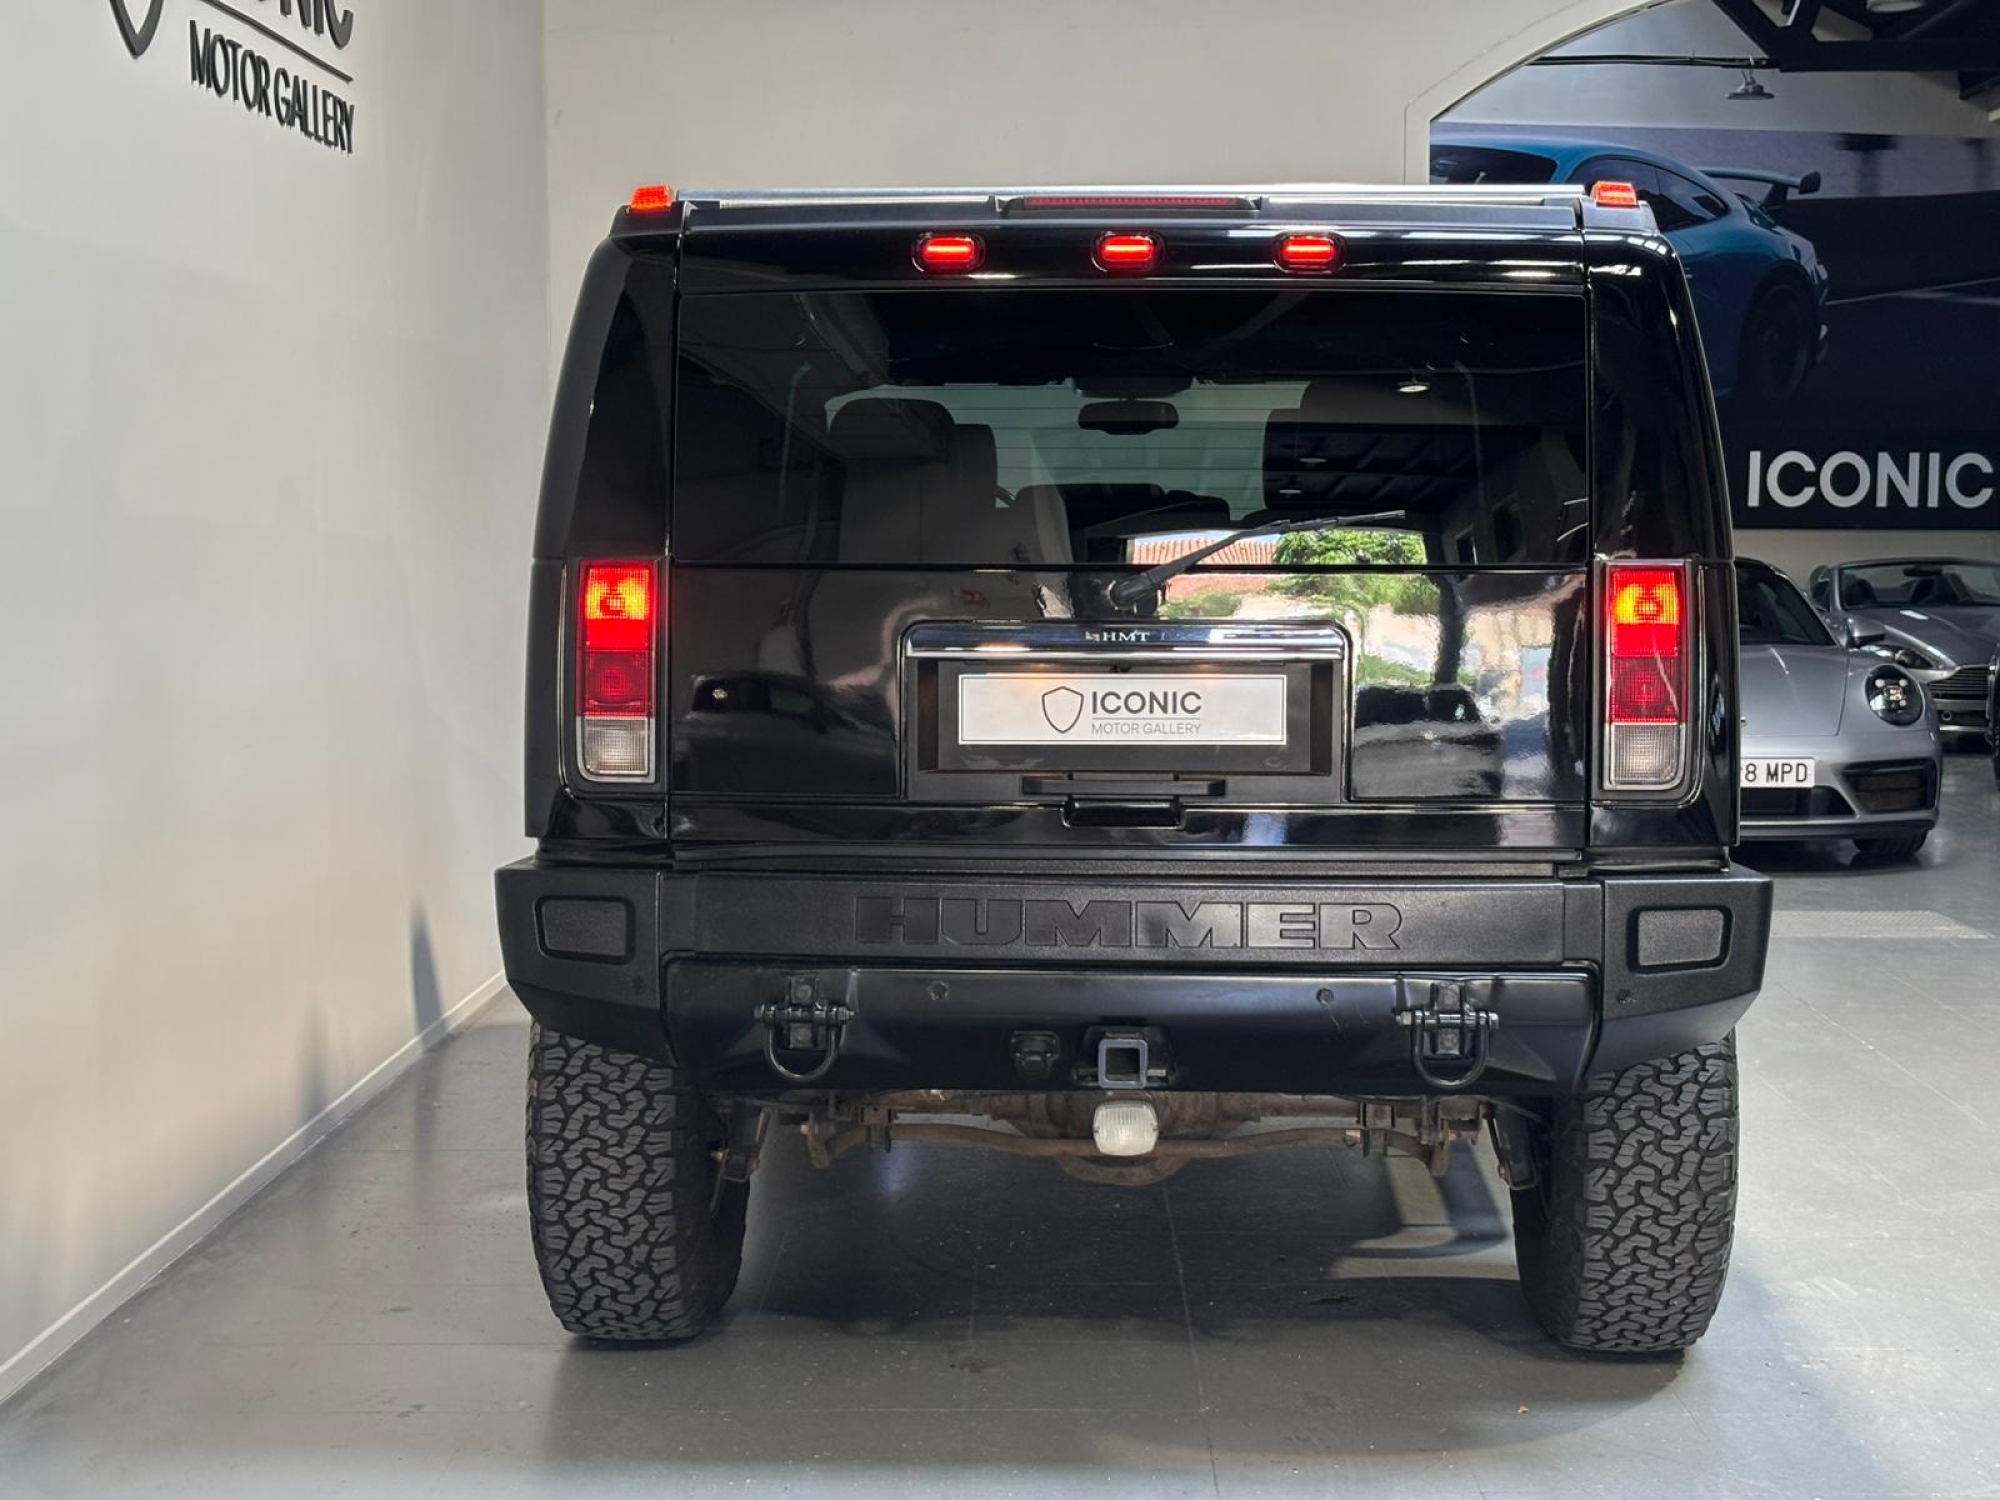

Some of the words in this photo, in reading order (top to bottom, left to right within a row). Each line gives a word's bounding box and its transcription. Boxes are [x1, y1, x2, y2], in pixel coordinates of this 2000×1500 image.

[190, 20, 272, 118] MOTOR
[273, 67, 355, 154] GALLERY
[1747, 450, 1995, 509] ICONIC
[1092, 691, 1202, 714] ICONIC
[1092, 722, 1140, 735] MOTOR
[1142, 722, 1201, 735] GALLERY
[1740, 763, 1757, 782] 8
[1766, 763, 1808, 783] MPD
[855, 897, 1403, 951] HUMMER
